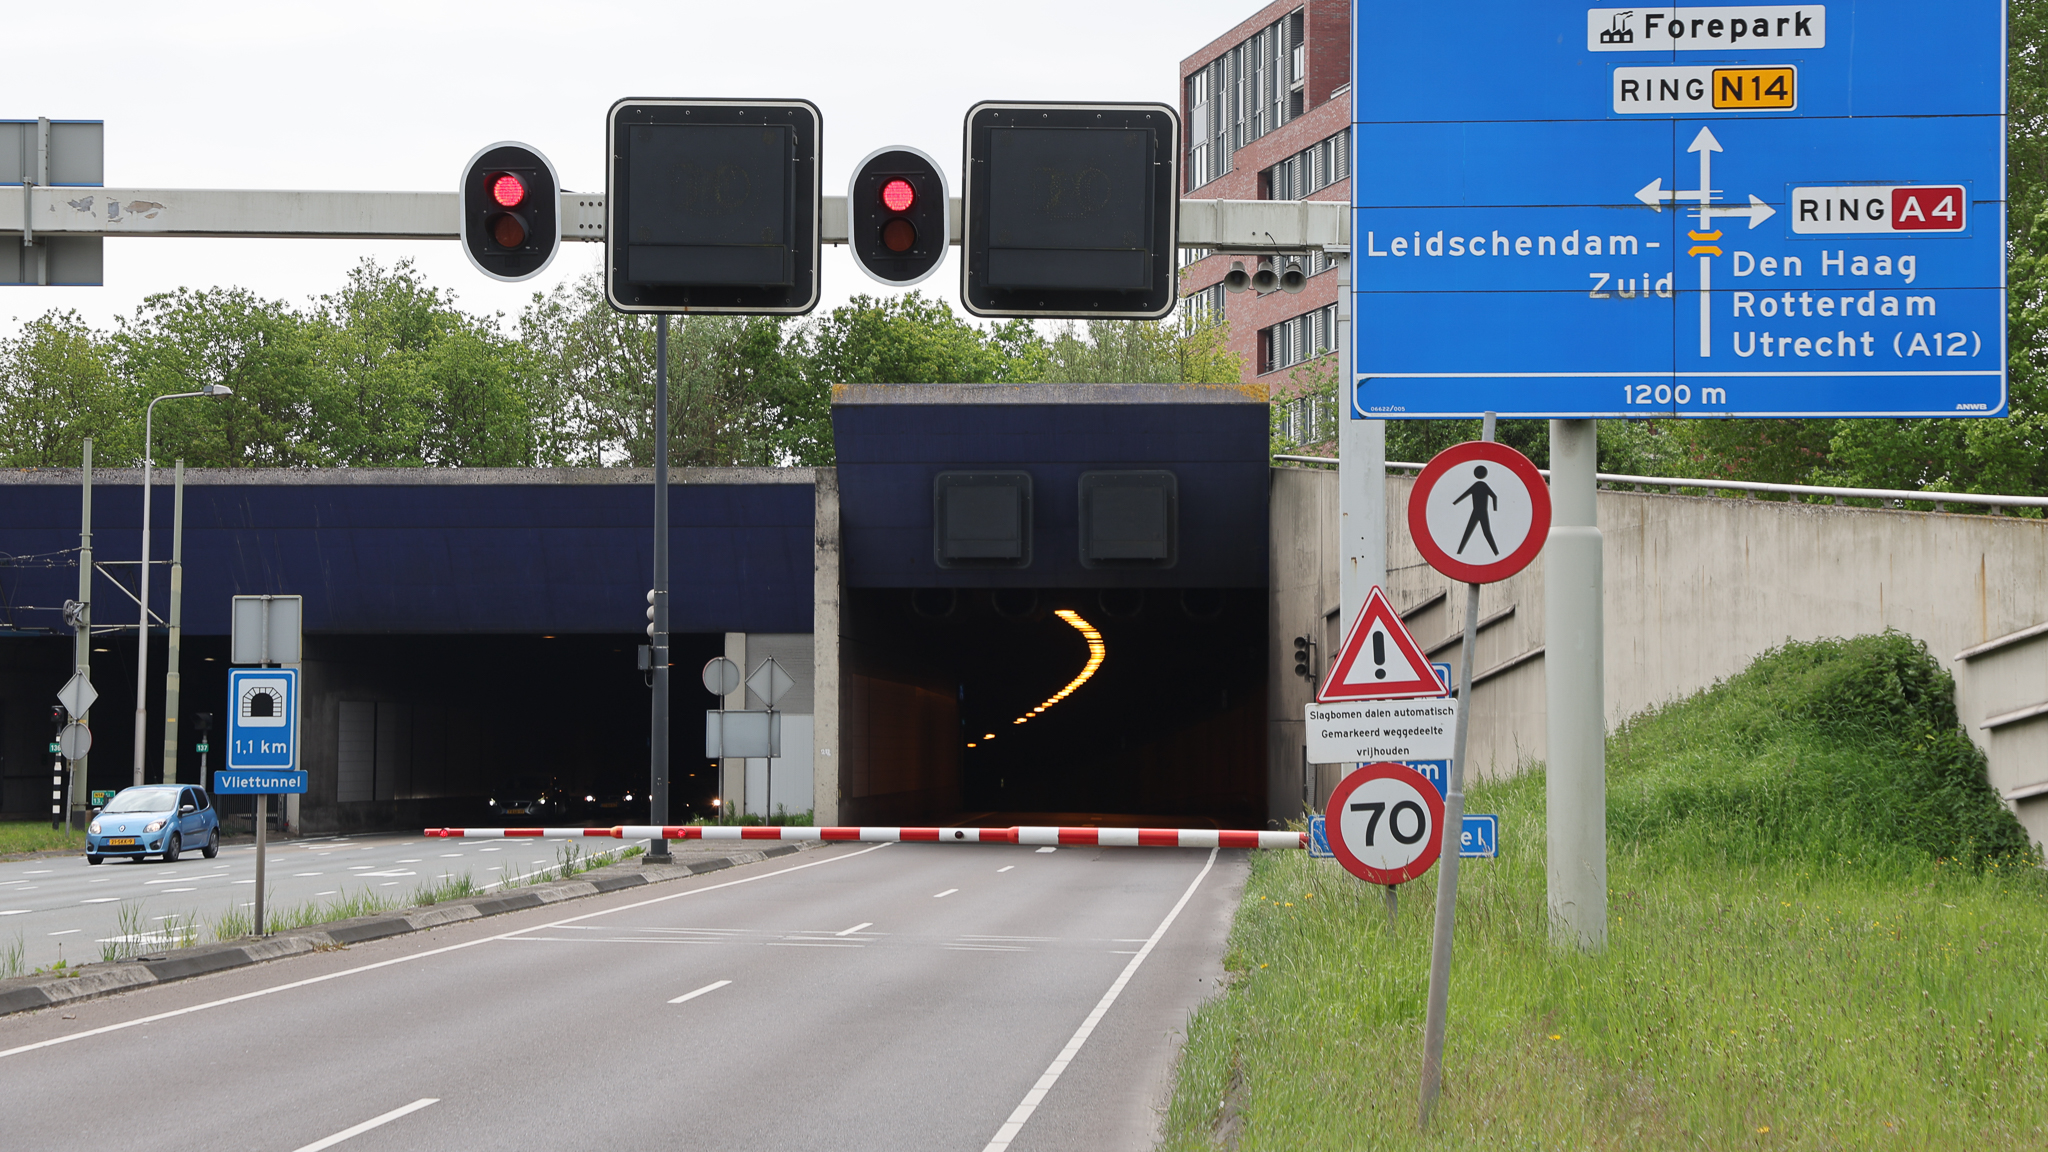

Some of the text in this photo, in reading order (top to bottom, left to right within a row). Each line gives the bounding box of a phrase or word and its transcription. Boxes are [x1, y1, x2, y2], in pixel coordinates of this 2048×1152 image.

[1646, 11, 1811, 44] Forepark
[1621, 75, 1789, 102] RING N14
[1800, 195, 1957, 222] RING A4
[1368, 229, 1660, 257] Leidschendam-
[1733, 251, 1916, 283] Den Haag
[1589, 272, 1673, 299] Zuid
[1733, 291, 1937, 317] Rotterdam
[1733, 331, 1982, 359] Utrecht (A12)
[1624, 385, 1727, 404] 1200 m
[1370, 404, 1406, 412] 06622/005
[1310, 706, 1454, 722] Slagbomen dalen automatisch
[1321, 726, 1444, 739] Gemarkeerd weggedeelte
[197, 744, 208, 752] 137
[235, 739, 287, 755] 1,1 km
[1356, 746, 1410, 758] vrijhouden
[221, 776, 301, 788] Vliettunnel
[1350, 800, 1426, 847] 70
